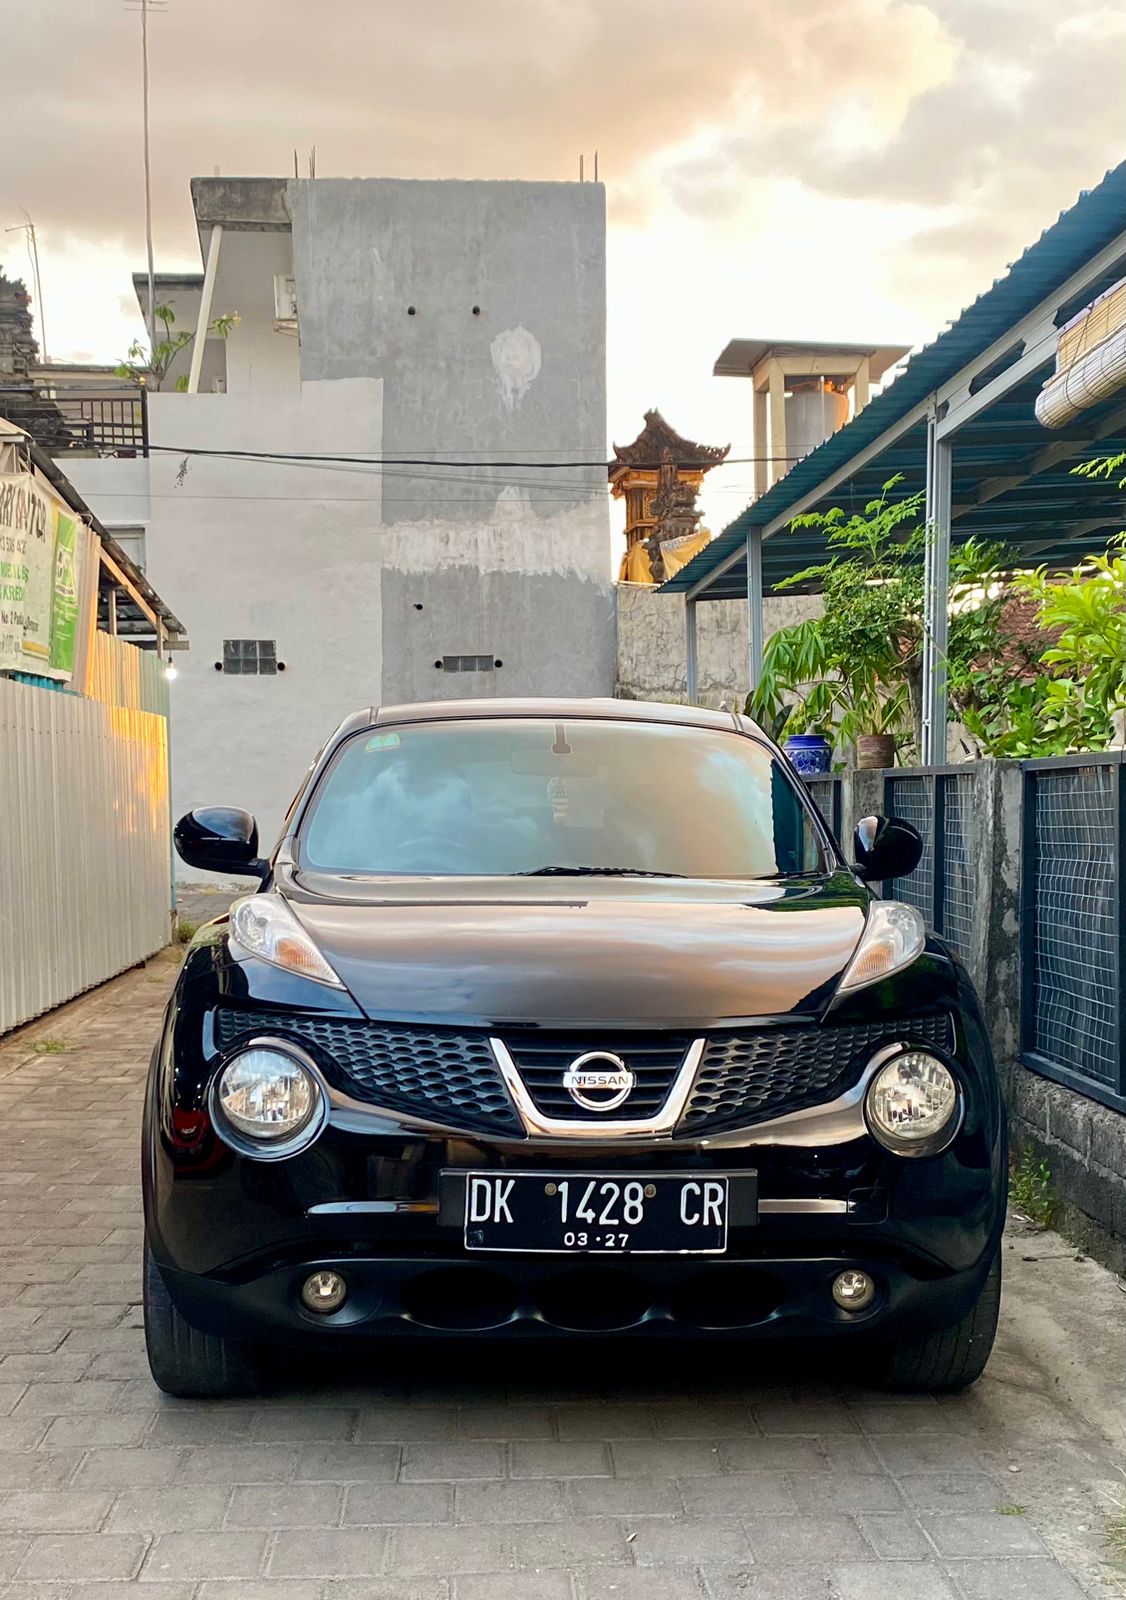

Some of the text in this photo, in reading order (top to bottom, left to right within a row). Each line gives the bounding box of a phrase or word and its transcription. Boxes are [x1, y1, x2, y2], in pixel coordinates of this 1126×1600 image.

[571, 1075, 629, 1085] NISSAN
[470, 1178, 724, 1226] DK 1428 CR
